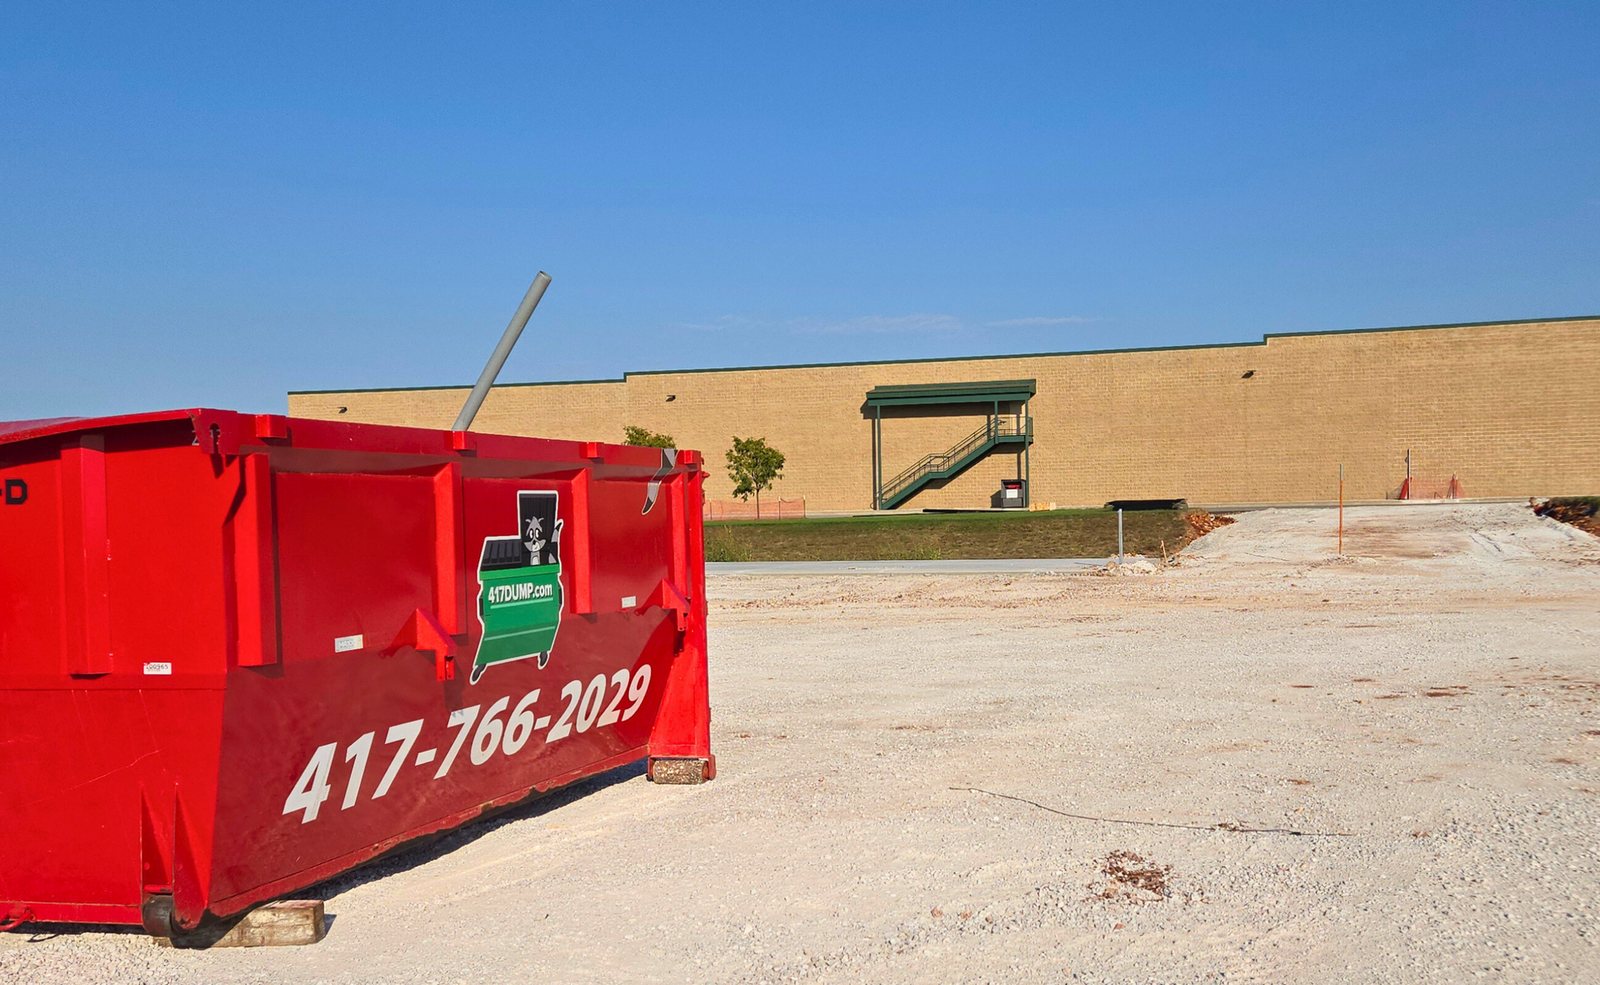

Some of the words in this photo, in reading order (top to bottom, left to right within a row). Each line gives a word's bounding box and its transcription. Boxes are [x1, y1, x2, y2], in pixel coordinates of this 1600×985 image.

[0, 479, 28, 505] D
[488, 582, 553, 603] 417DUMP.com
[281, 663, 652, 824] 417-766-2029
